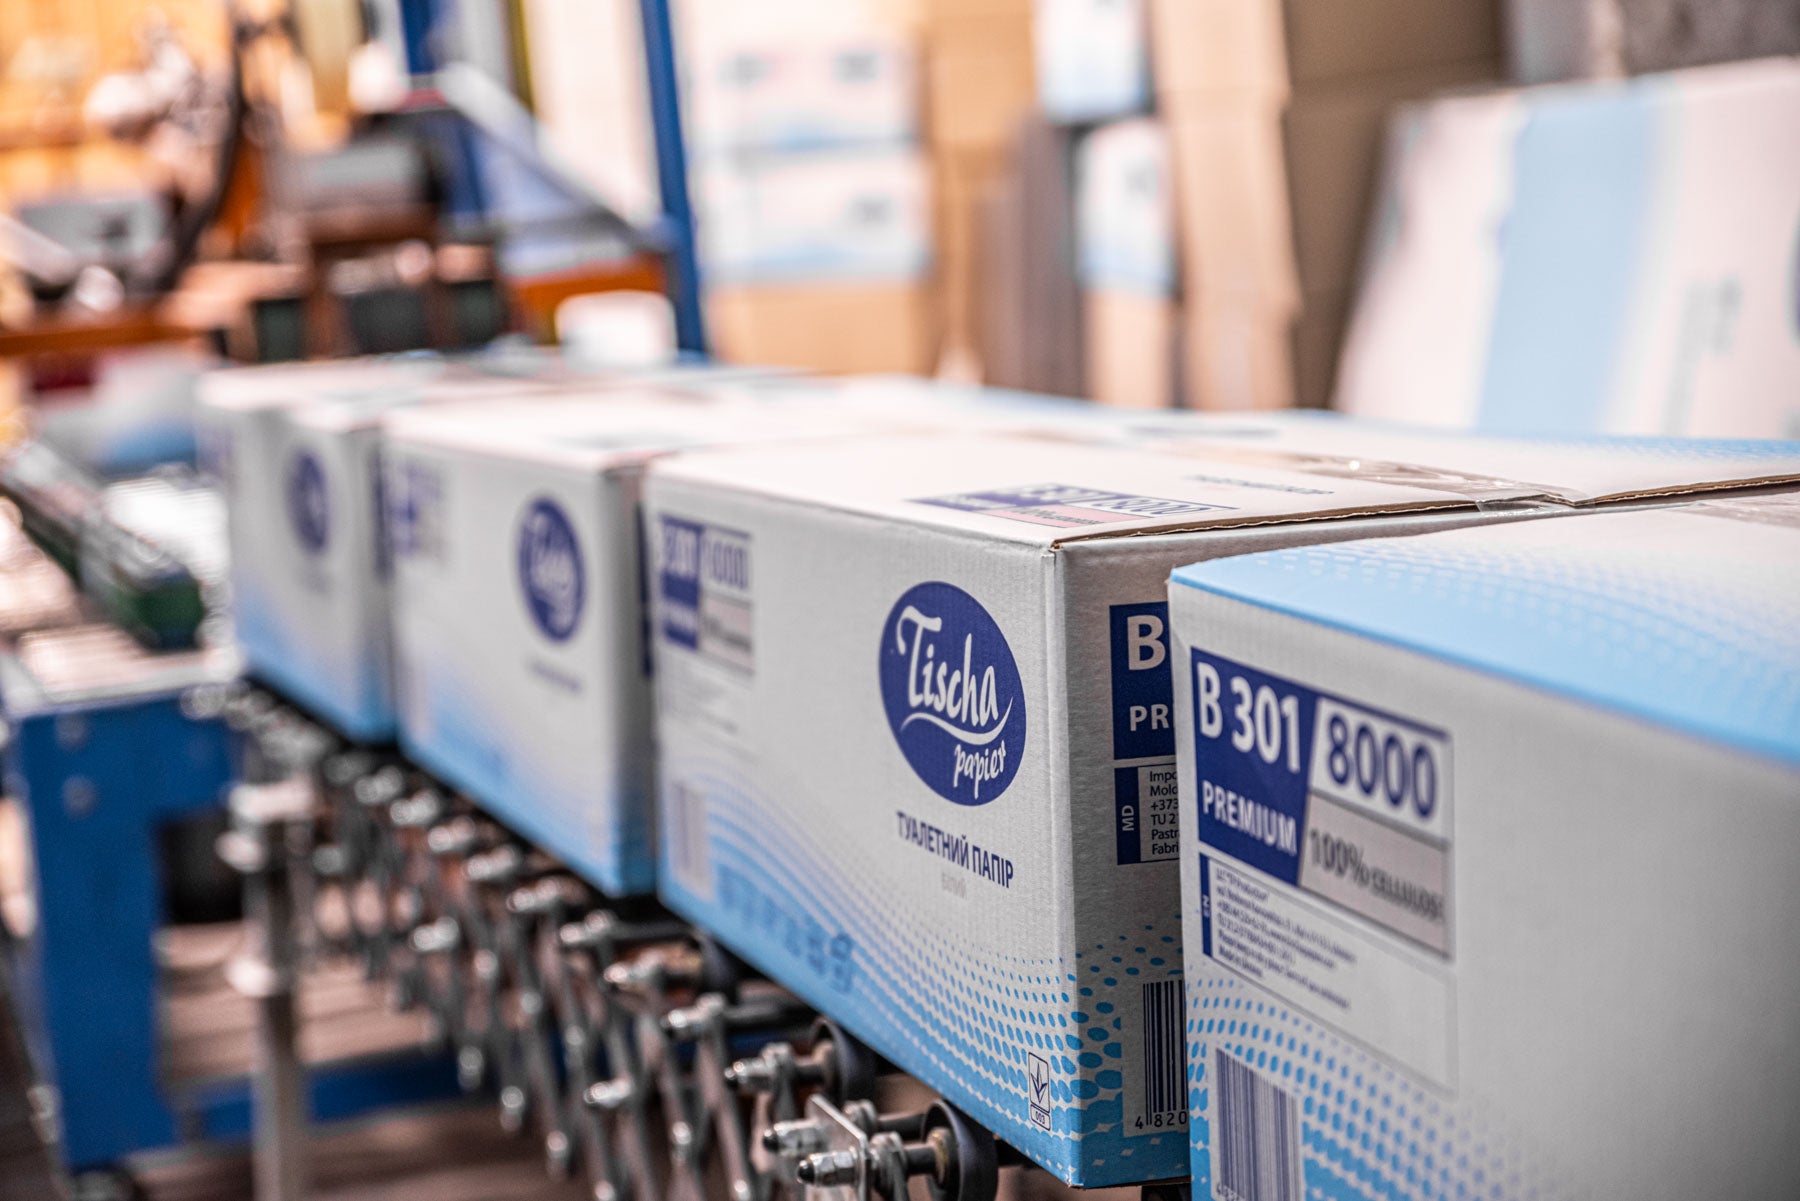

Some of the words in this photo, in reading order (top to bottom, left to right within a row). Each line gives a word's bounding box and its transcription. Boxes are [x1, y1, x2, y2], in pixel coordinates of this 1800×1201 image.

[896, 605, 999, 728] Tischa
[1127, 614, 1166, 672] B
[1197, 661, 1223, 738] B
[1230, 675, 1300, 774] 301
[953, 739, 1007, 800] papier
[1327, 711, 1437, 822] 8000
[896, 810, 970, 870] ТУАЛЕТНИЙ
[972, 844, 1013, 888] ПАПІР
[1122, 804, 1135, 832] MD
[1150, 813, 1166, 826] TU
[1202, 779, 1298, 856] PREMIUM
[1310, 828, 1370, 889] 100%
